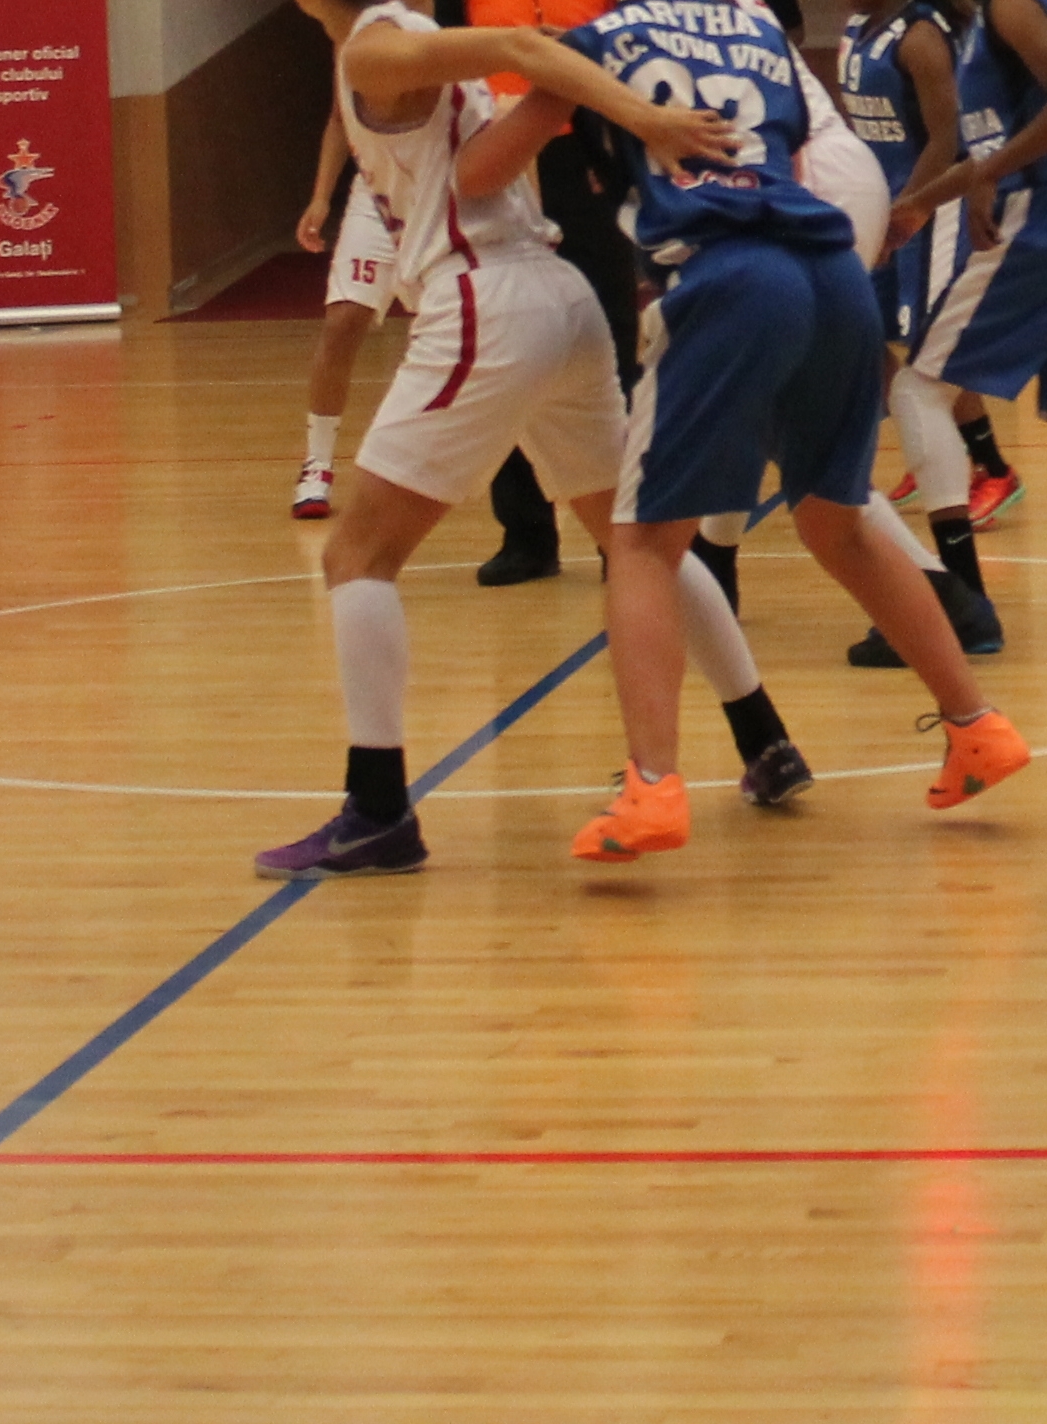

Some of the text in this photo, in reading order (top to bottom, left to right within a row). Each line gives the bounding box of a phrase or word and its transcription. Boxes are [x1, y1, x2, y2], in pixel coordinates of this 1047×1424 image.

[594, 0, 762, 39] BARTHA
[32, 45, 80, 60] oficial
[728, 43, 792, 87] VITA
[1, 66, 63, 82] clubului
[351, 258, 379, 284] 15
